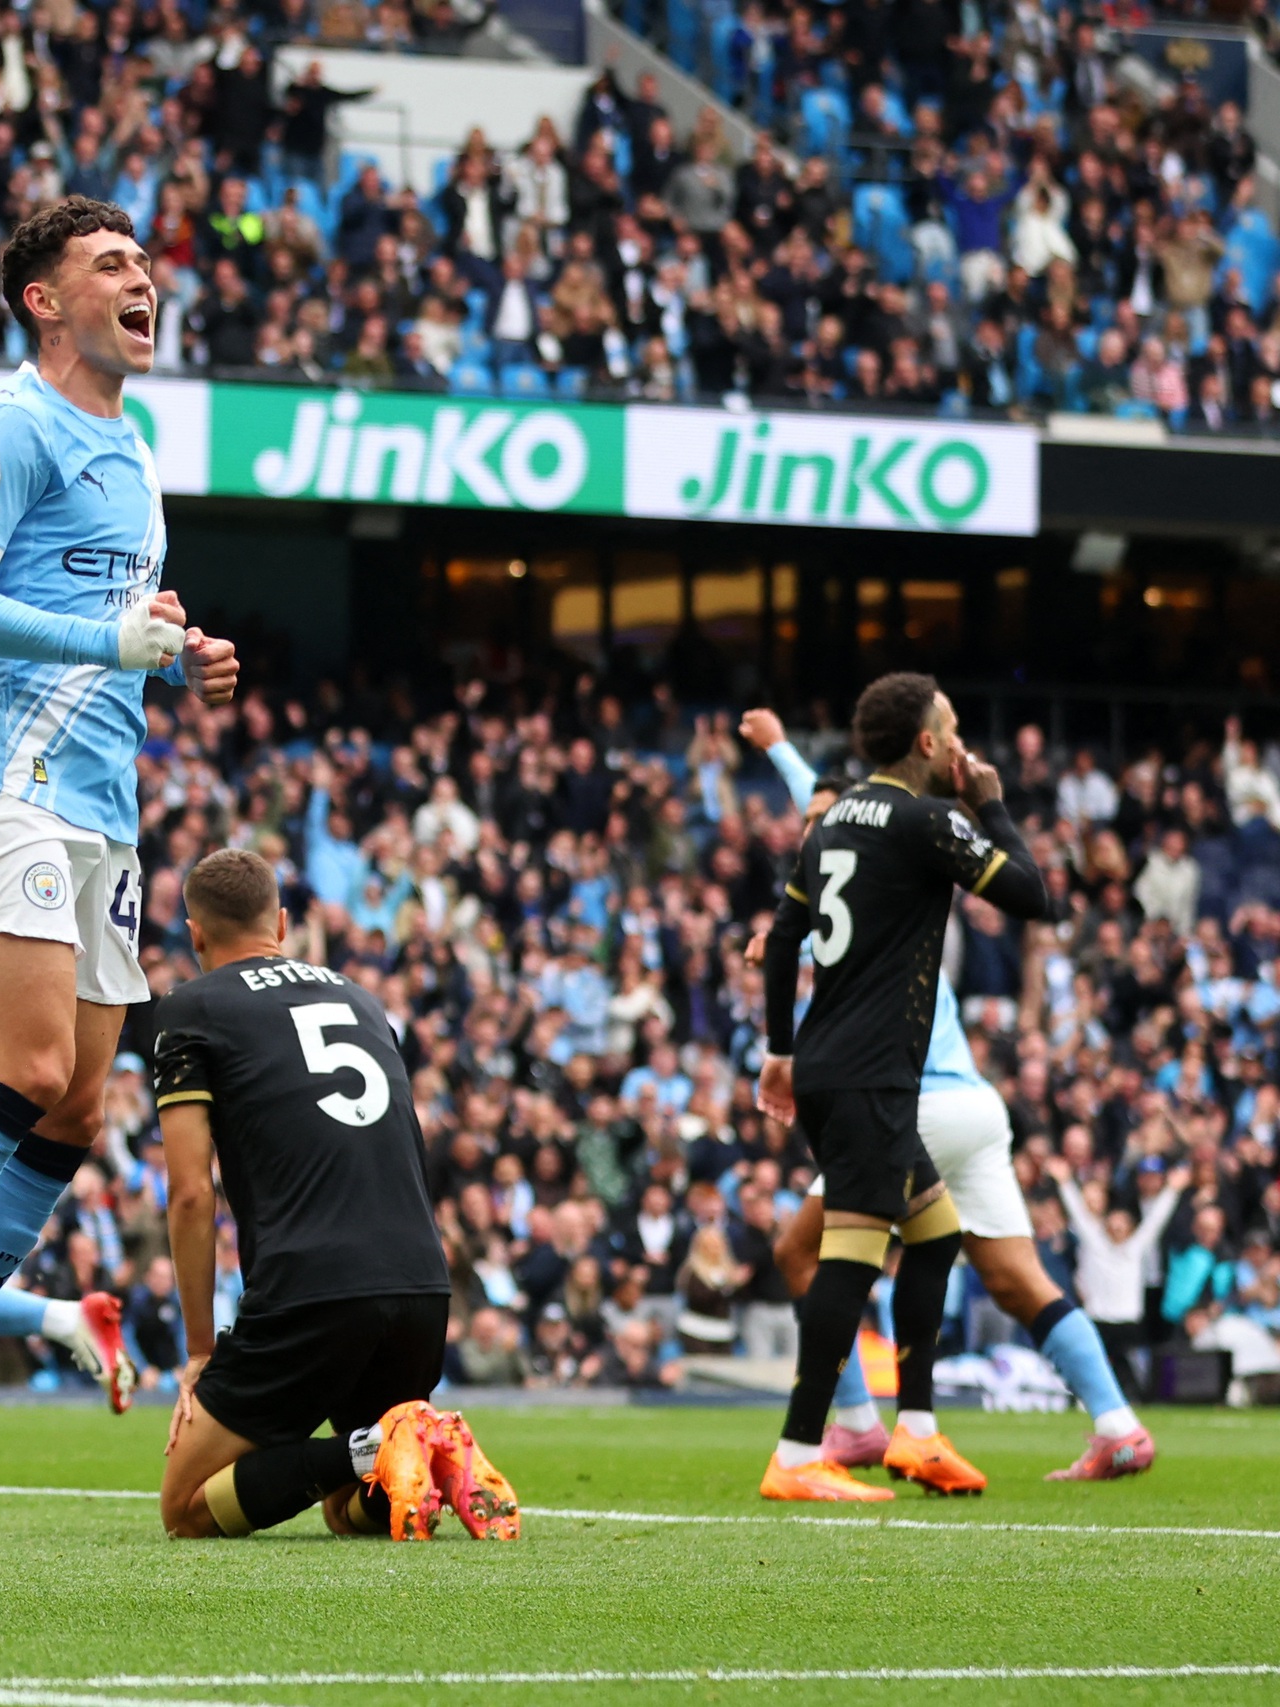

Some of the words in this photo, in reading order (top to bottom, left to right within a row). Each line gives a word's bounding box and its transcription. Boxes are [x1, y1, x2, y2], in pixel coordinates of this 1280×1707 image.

[61, 547, 164, 588] ETIHA
[110, 869, 144, 941] 4
[811, 849, 858, 968] 3
[289, 1002, 390, 1127] 5
